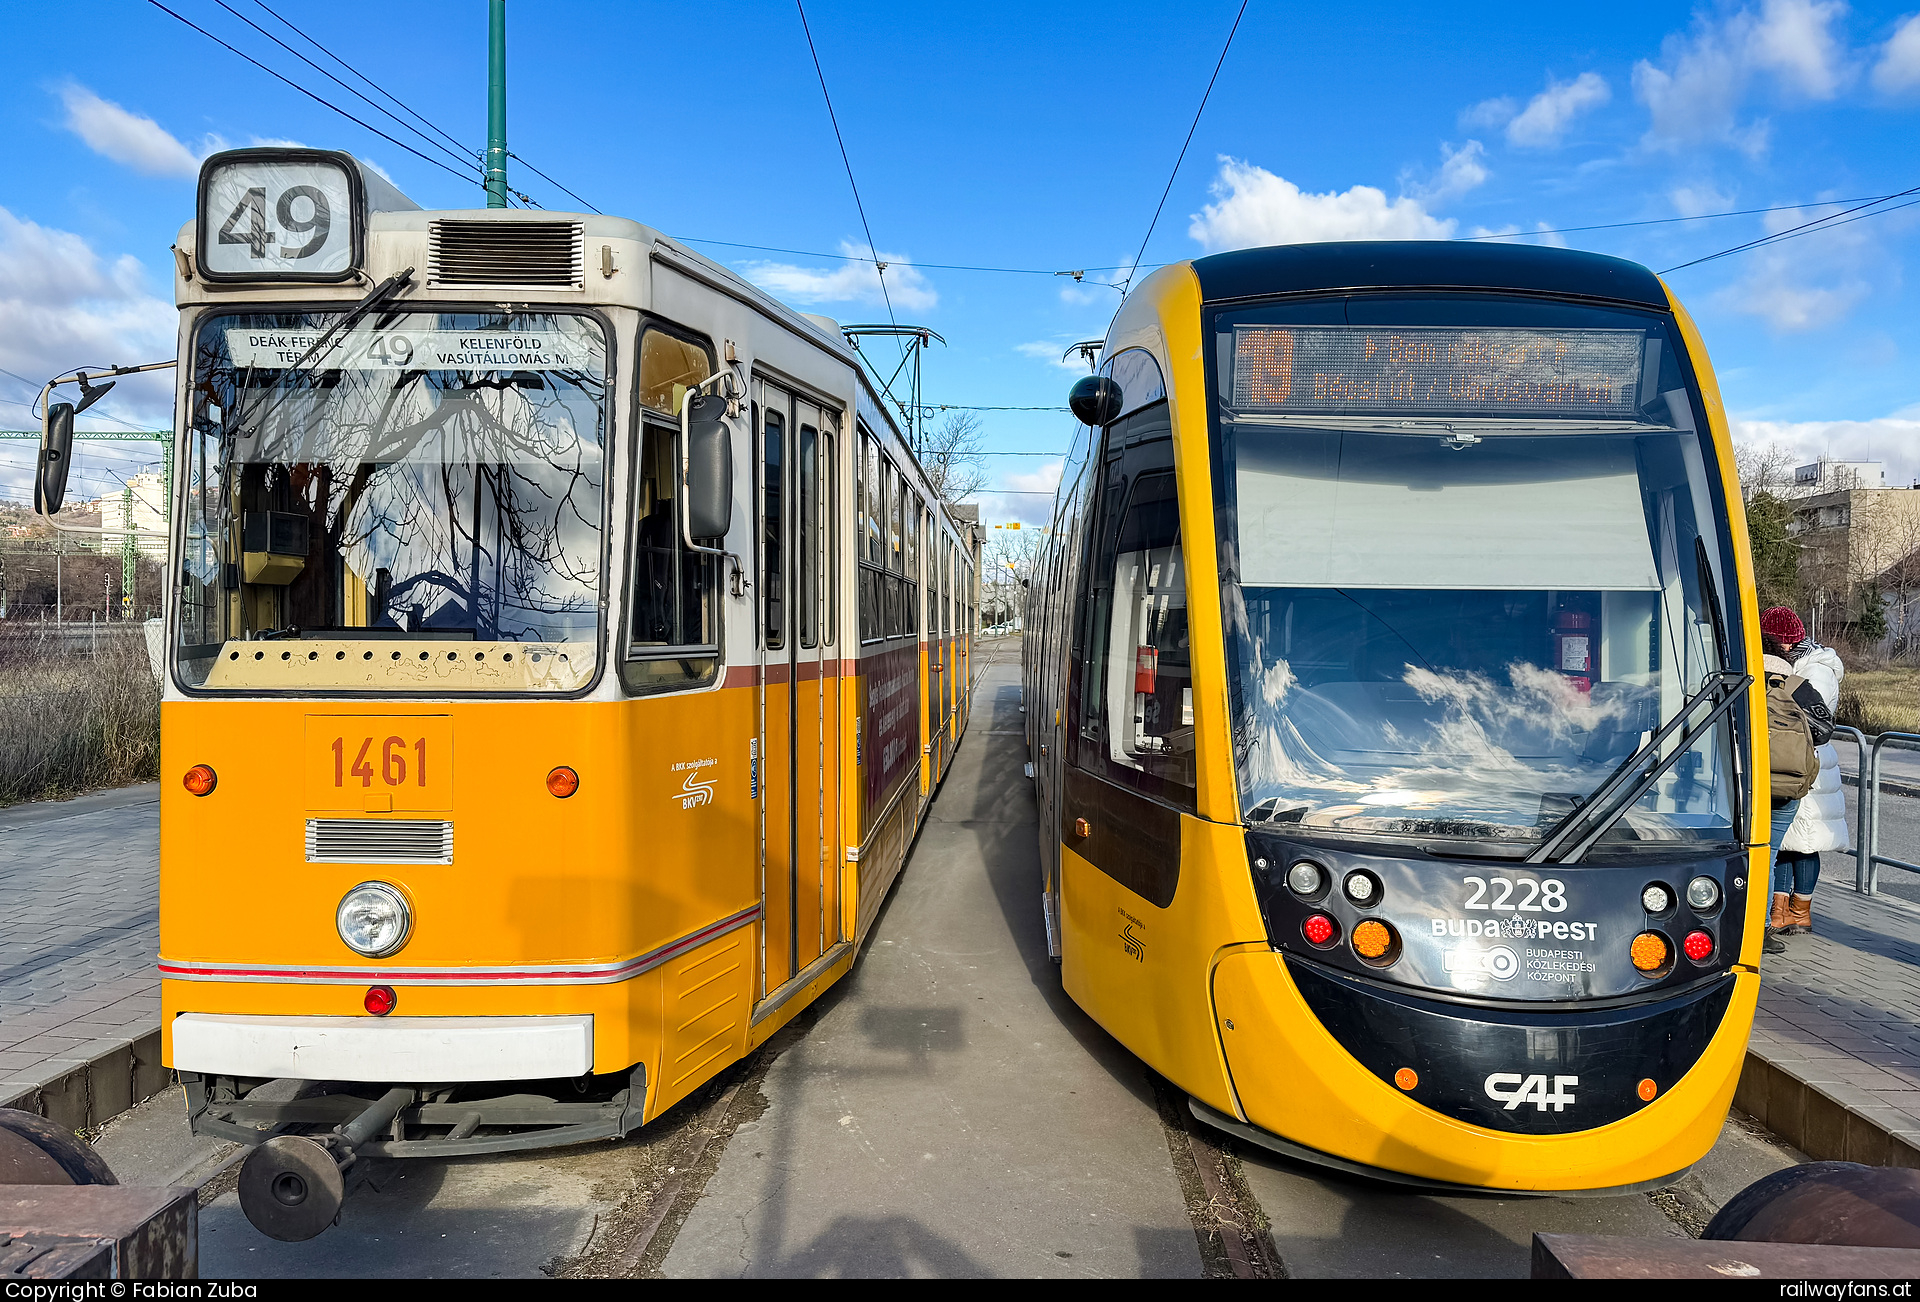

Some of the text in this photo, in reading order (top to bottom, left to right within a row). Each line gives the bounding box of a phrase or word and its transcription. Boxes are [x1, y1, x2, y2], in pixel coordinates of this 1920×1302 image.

[219, 185, 331, 259] 49
[250, 334, 287, 347] DEÁK
[366, 335, 414, 366] 49
[460, 336, 542, 350] KELENFÖLD
[1389, 335, 1544, 366] Bem rakpart
[437, 350, 569, 365] VASÚTÁLLOMÁS M
[1239, 330, 1293, 402] 19
[331, 735, 426, 787] 1461
[1463, 876, 1568, 913] 2228
[1526, 949, 1583, 960] BUDAPESTI
[1526, 960, 1596, 973] KÖZLEKEDÉSI
[1527, 971, 1576, 983] KÖZPONT
[1484, 1072, 1579, 1112] CAF
